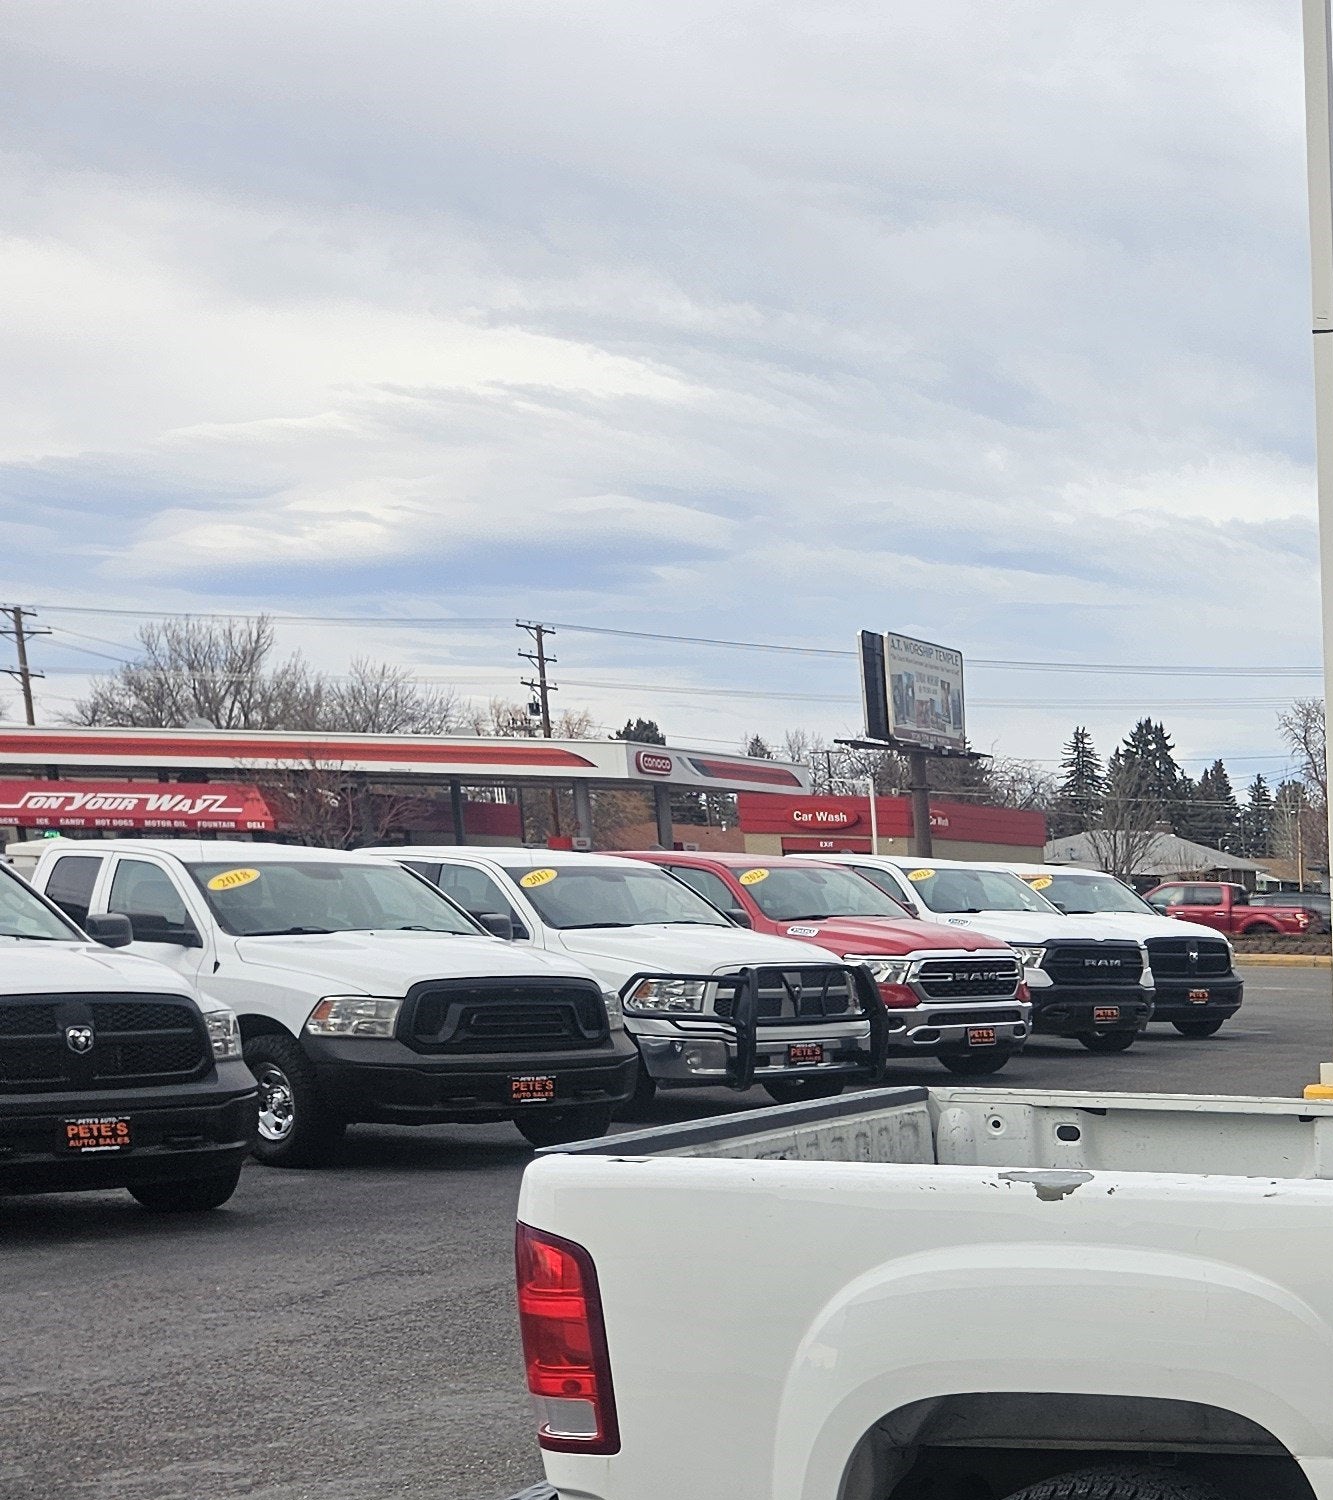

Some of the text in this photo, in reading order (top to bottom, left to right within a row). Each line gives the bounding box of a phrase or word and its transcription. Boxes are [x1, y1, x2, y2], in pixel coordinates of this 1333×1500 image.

[935, 649, 959, 667] TEMPLE
[793, 811, 848, 823] Car Wash
[197, 821, 236, 829] FOUNTAIN
[246, 821, 265, 829] DELI
[1084, 959, 1121, 967] RAM
[512, 1080, 554, 1091] PETE'S
[66, 1122, 129, 1138] PETE'S
[69, 1136, 130, 1147] AUTO SALES
